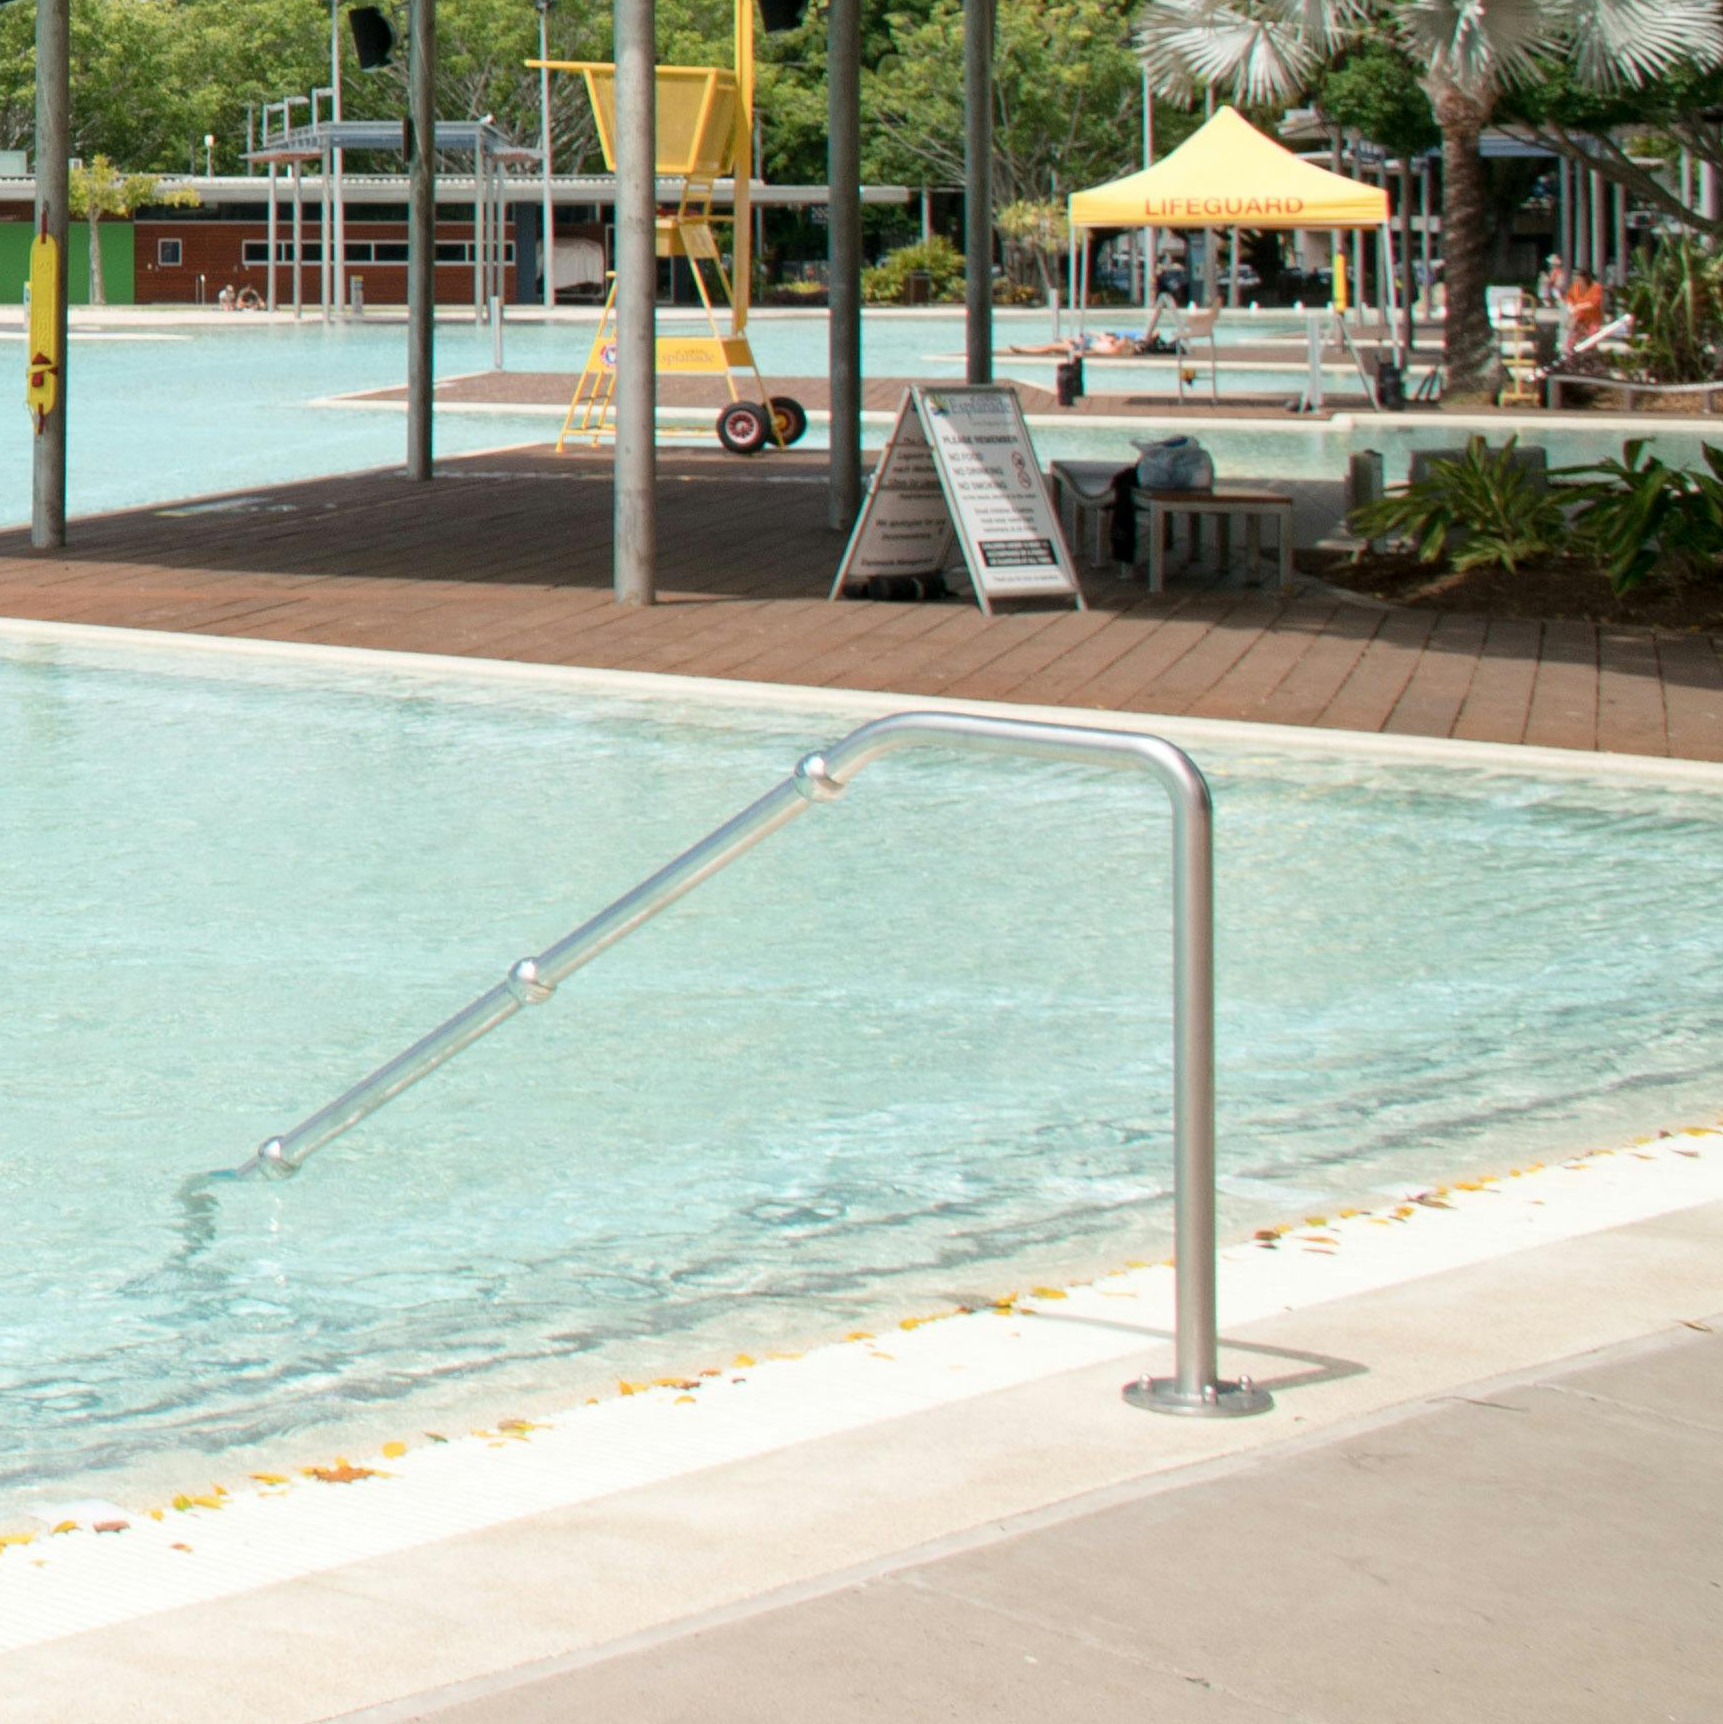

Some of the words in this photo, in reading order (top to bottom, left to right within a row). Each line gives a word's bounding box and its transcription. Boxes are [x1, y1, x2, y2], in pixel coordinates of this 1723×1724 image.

[1145, 196, 1304, 216] LIFEGUARD
[661, 349, 715, 366] splanade
[942, 434, 972, 444] PLEASE
[974, 434, 1019, 444] REMEMBER
[961, 452, 983, 461] FOOD
[971, 481, 1008, 490] SMOKING
